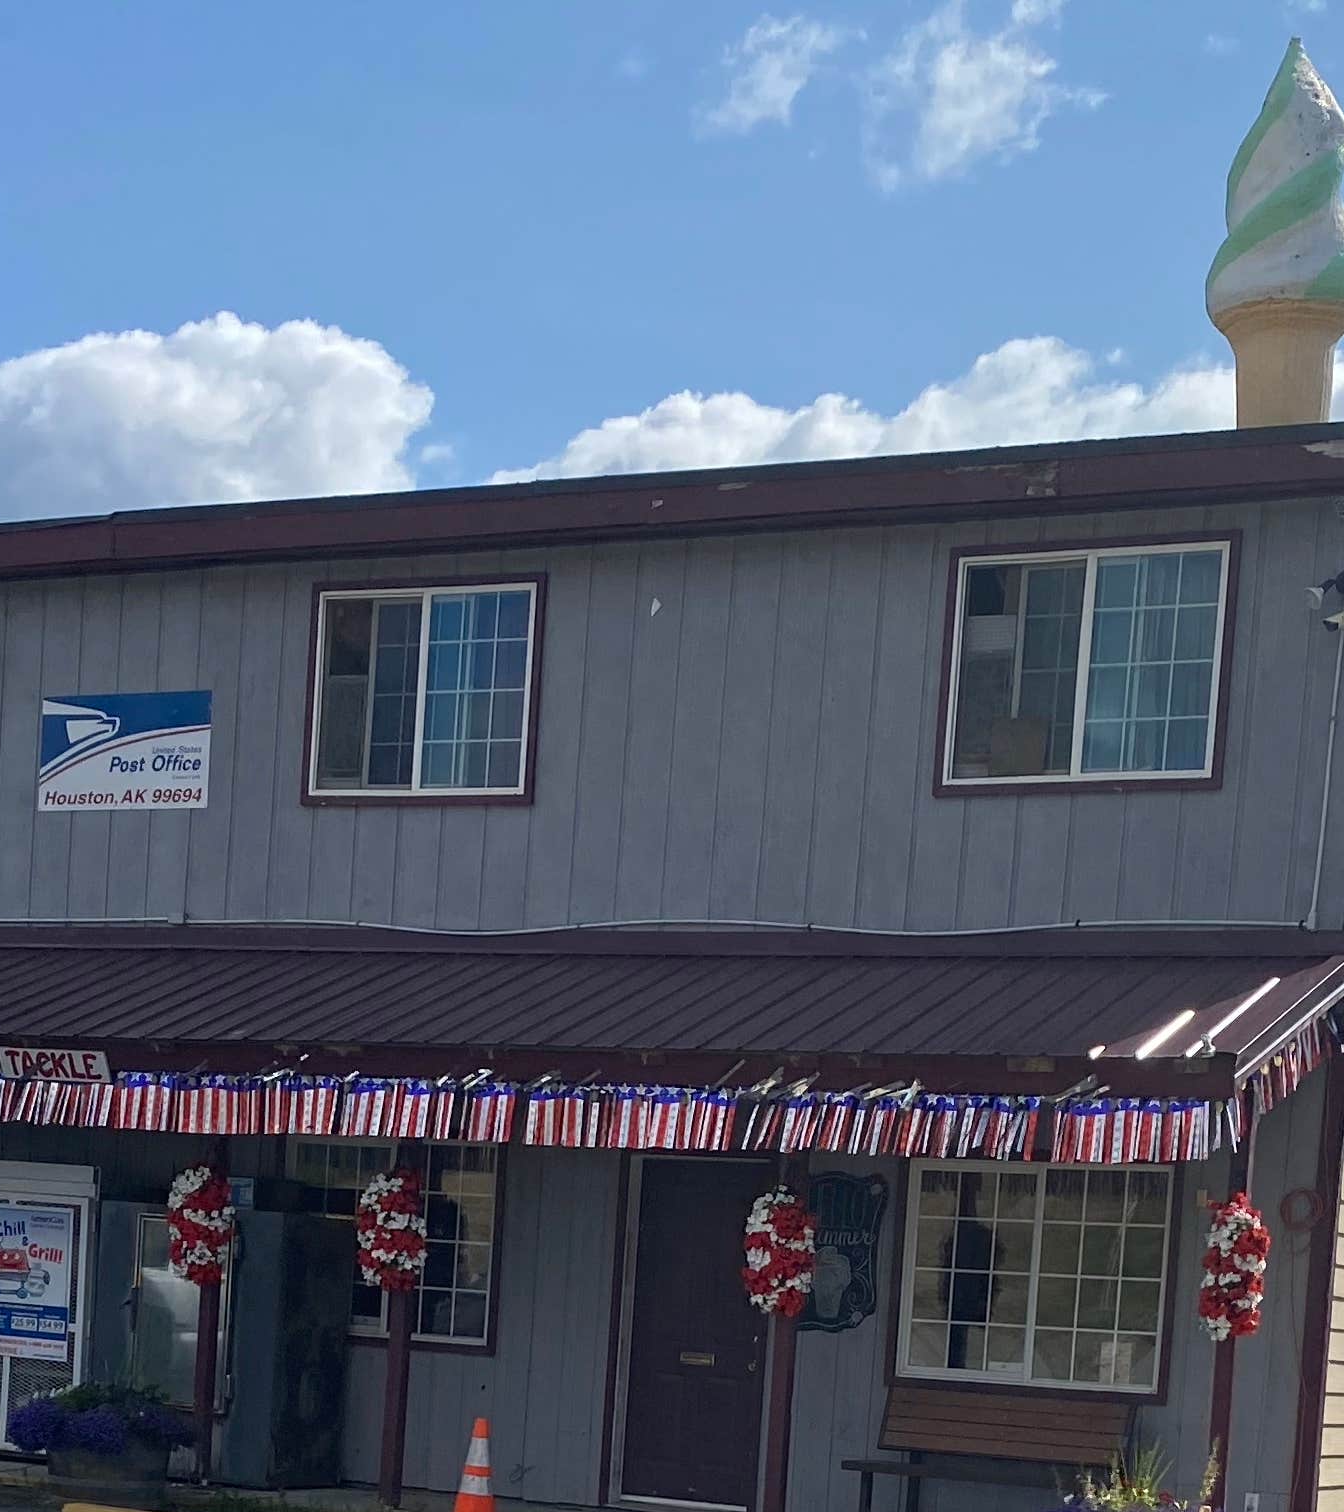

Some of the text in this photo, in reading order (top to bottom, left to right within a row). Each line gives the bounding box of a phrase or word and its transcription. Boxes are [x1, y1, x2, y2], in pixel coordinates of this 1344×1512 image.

[109, 754, 201, 772] Post Office
[44, 787, 202, 806] Houston, AK 99694
[4, 1050, 102, 1079] TACKLE
[28, 1243, 64, 1264] Grill!
